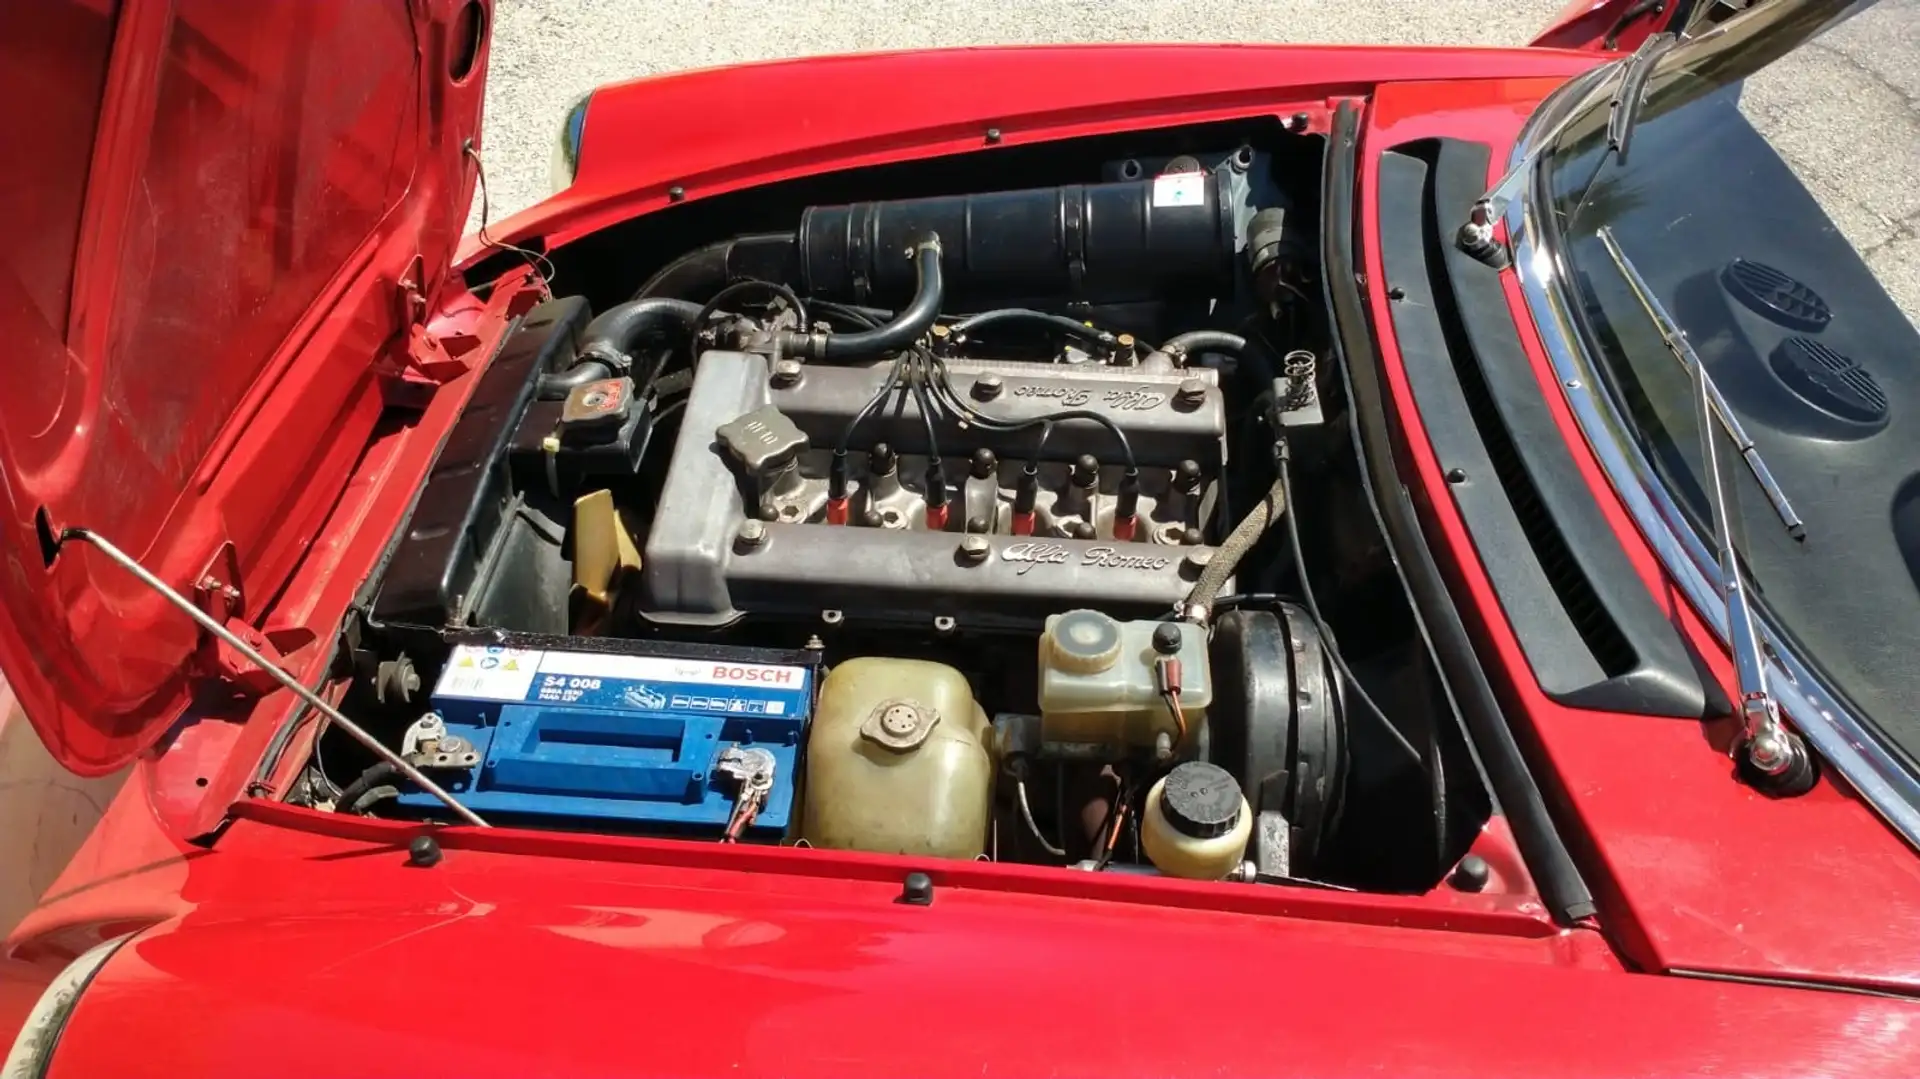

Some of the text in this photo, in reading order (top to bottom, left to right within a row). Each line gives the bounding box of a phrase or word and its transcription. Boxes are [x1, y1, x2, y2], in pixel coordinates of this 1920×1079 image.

[1013, 386, 1166, 411] Alfa Romeo
[1002, 543, 1170, 575] Alfa Romeo
[543, 676, 602, 690] S4 008
[712, 666, 792, 684] BOSCH
